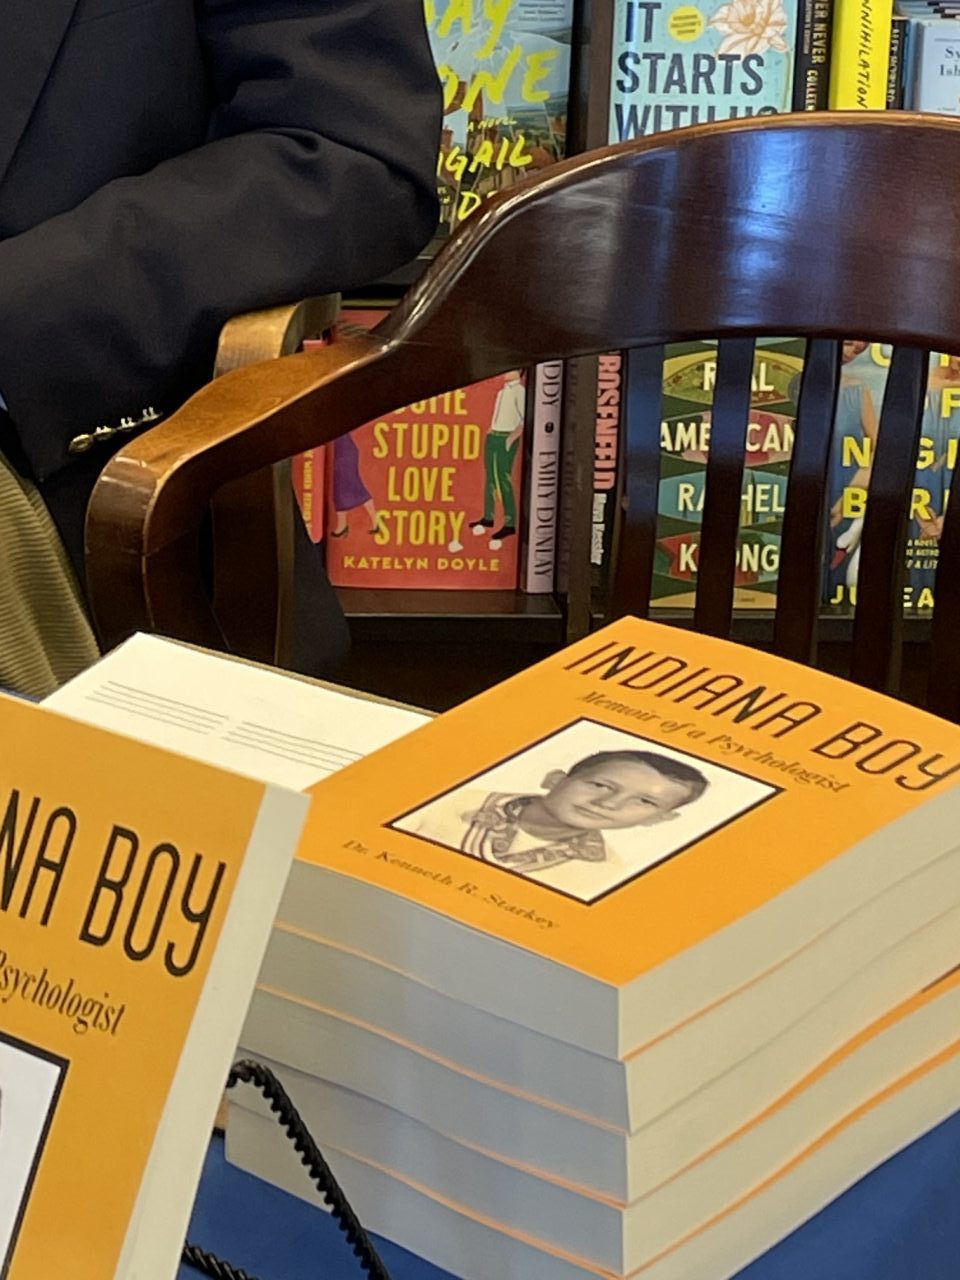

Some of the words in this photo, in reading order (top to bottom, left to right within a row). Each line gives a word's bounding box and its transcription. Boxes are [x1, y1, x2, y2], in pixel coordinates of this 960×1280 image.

[624, 1, 663, 43] IT
[811, 22, 828, 64] NEVER
[615, 51, 765, 96] STARTS
[804, 69, 819, 112] COLLEEN
[372, 422, 481, 460] STUPID
[592, 354, 621, 490] ROSENFELD
[387, 466, 457, 502] LOVE
[536, 451, 557, 498] EMILY
[373, 509, 466, 547] STORY
[533, 506, 555, 578] DUNLAY
[343, 556, 429, 570] KATELYN
[437, 557, 500, 572] DOYLE
[563, 639, 824, 740] INDIANA
[809, 720, 960, 792] BOY
[576, 690, 663, 723] Memoir
[660, 717, 686, 735] of
[686, 727, 706, 740] a
[707, 731, 851, 795] Psychologist
[79, 823, 228, 978] BOY
[341, 838, 369, 856] Dr.
[375, 849, 454, 888] Kenneth
[487, 891, 560, 931] Starkey
